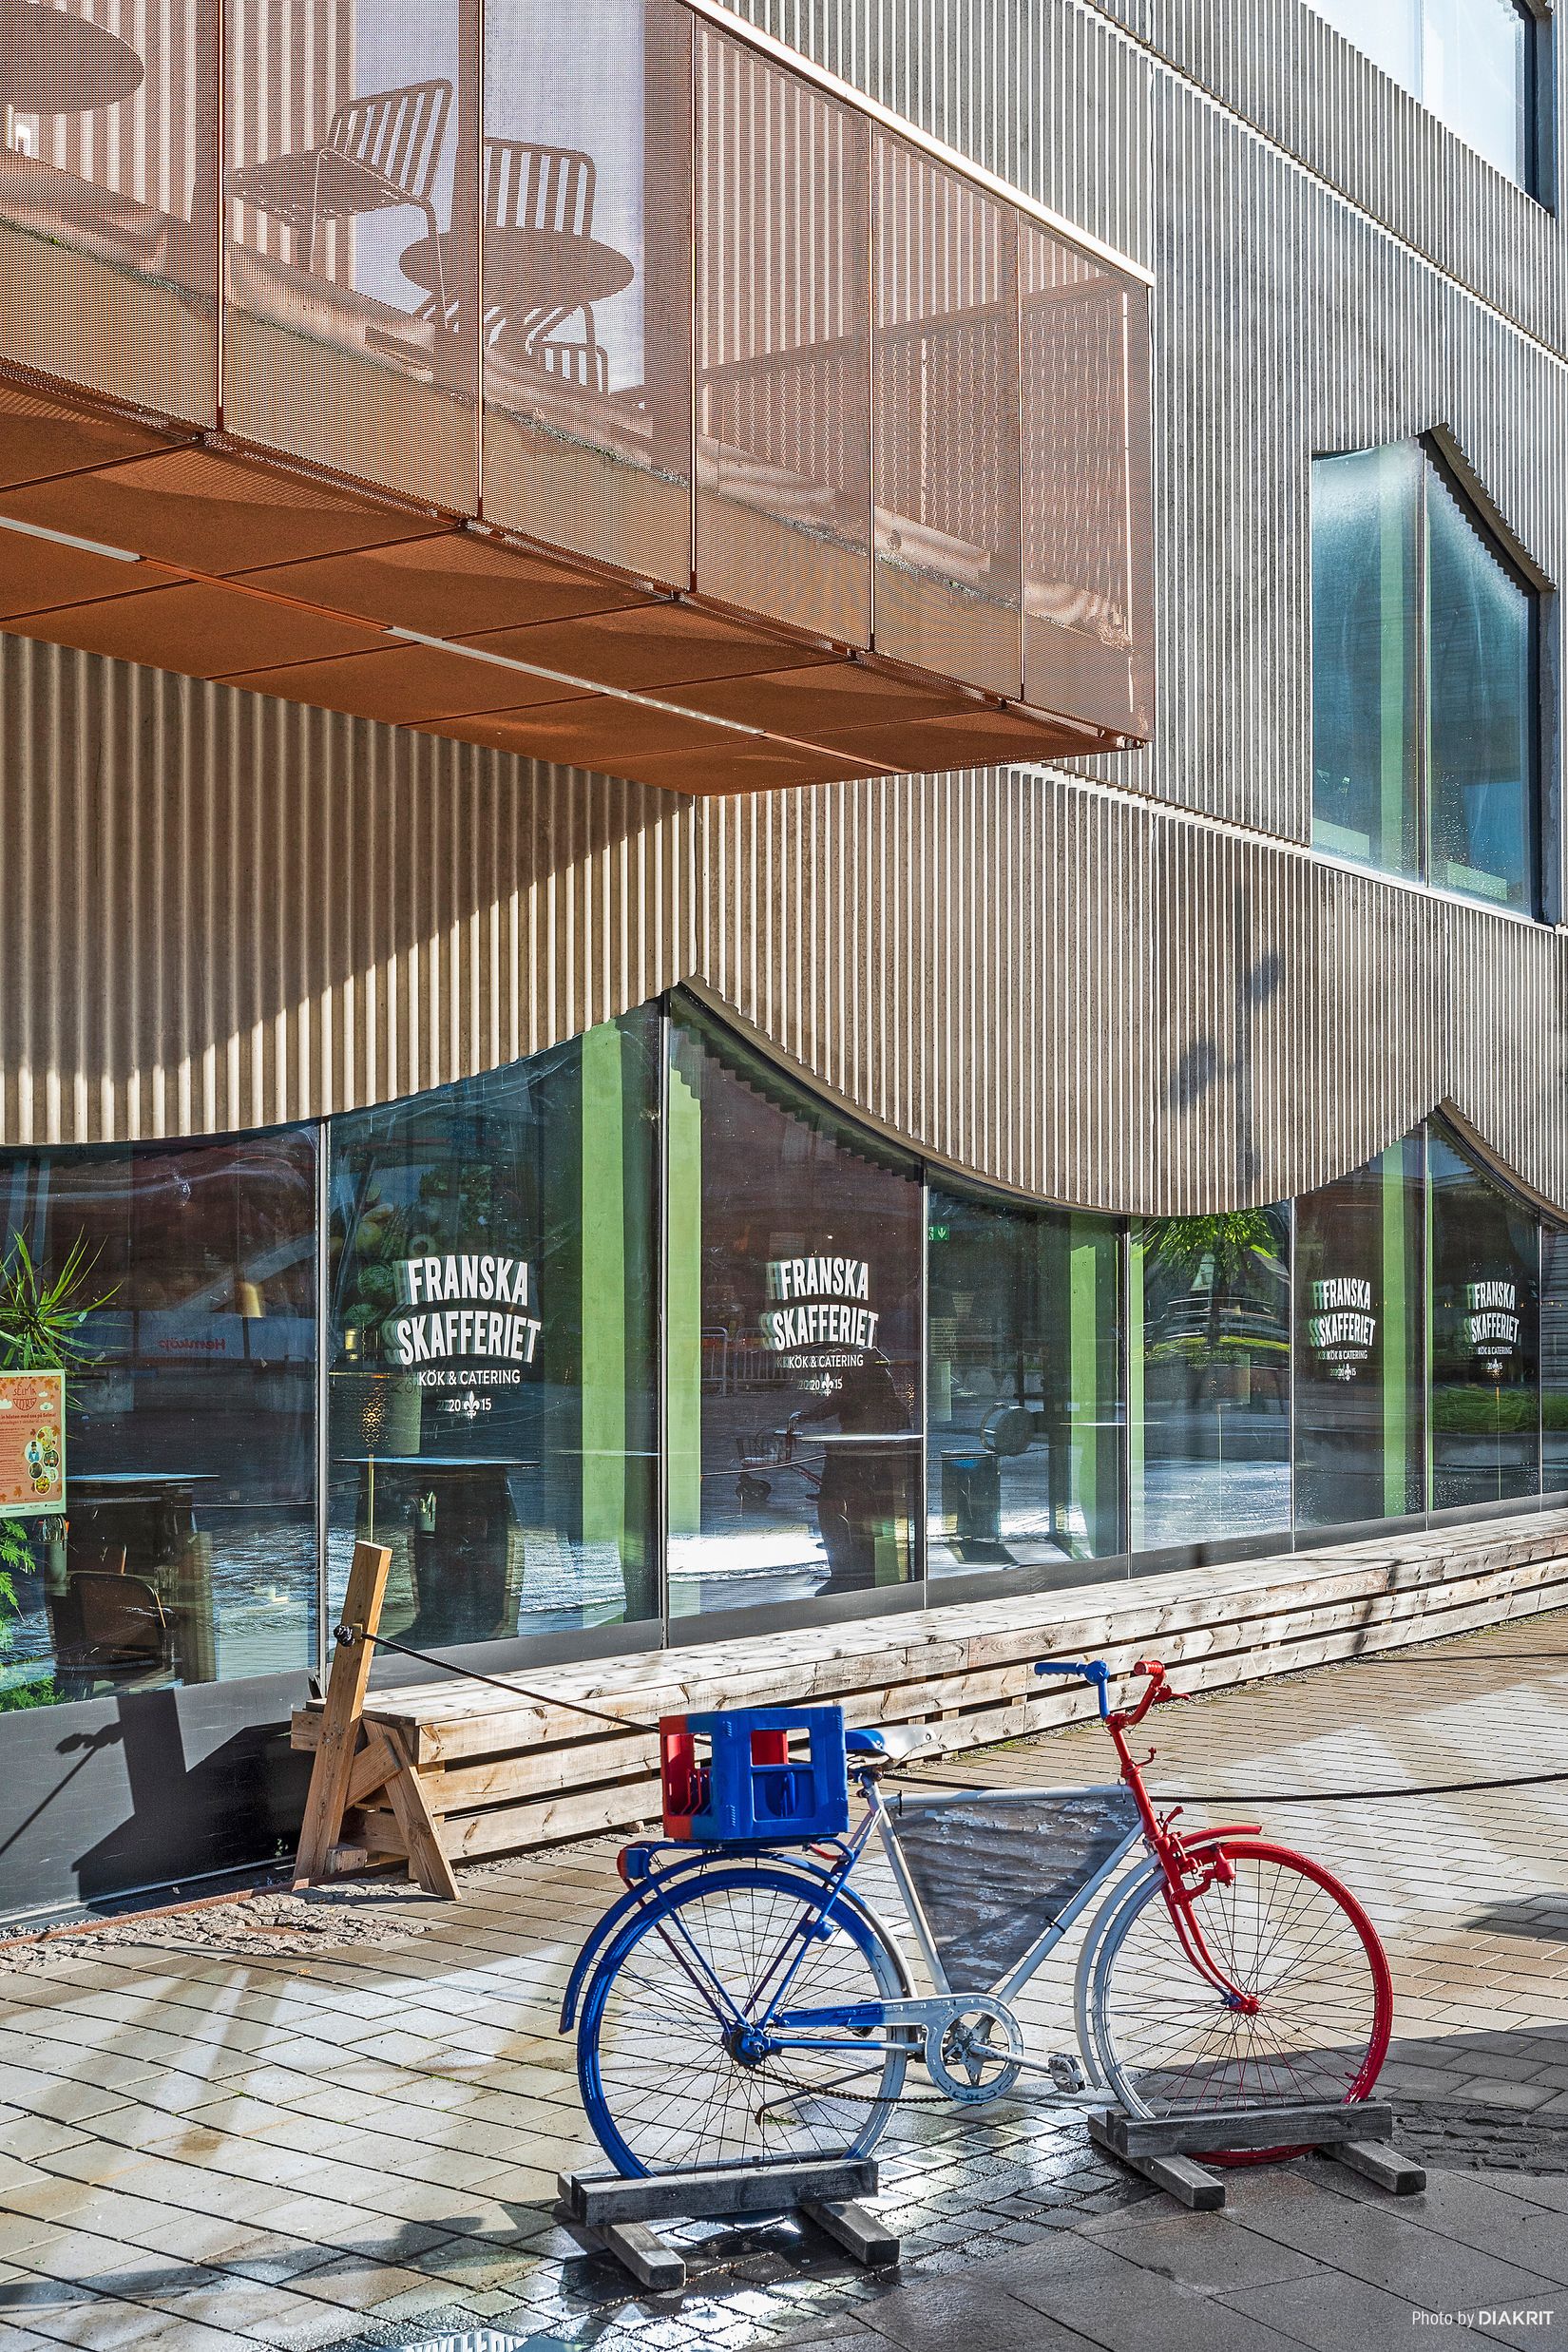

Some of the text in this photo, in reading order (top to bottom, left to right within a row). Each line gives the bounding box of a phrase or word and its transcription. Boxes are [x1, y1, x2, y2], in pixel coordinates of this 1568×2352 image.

[408, 1254, 528, 1307] FRANSKA
[780, 1257, 869, 1300] FRANSKA
[1323, 1278, 1370, 1310] FRANSKA
[1475, 1281, 1515, 1310] FRANSKA
[396, 1310, 542, 1366] SKAFFERIET
[773, 1305, 879, 1350] SKAFFERIET
[1319, 1312, 1376, 1347] SKAFFERIET
[1471, 1312, 1520, 1343] SKAFFERIET
[789, 1354, 864, 1368] KÖK & CATERING
[1327, 1349, 1338, 1360] KÖK
[1343, 1350, 1368, 1360] CATERING
[419, 1369, 521, 1386] KÖK & CATERING
